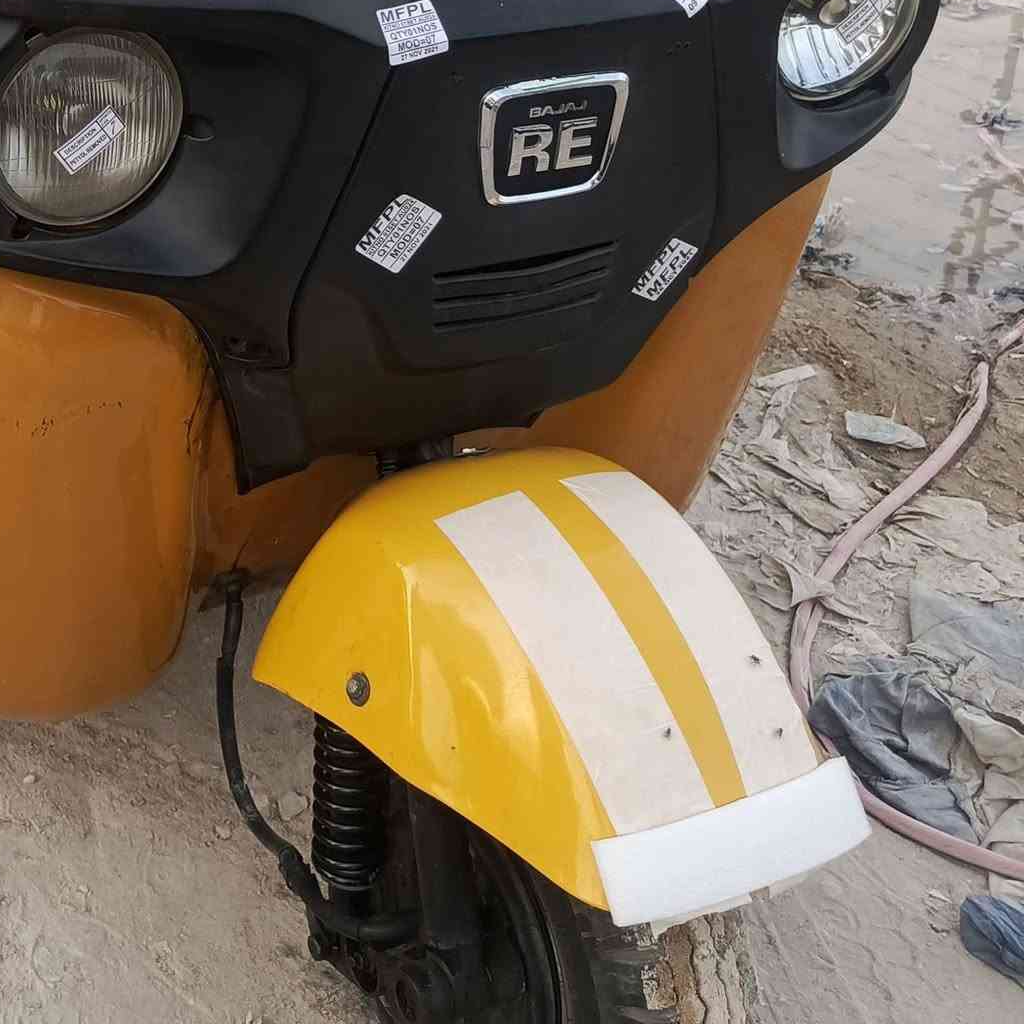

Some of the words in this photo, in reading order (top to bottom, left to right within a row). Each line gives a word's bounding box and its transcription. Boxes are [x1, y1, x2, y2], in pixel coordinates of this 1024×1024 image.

[380, 3, 433, 23] MFPL
[687, 0, 698, 11] 09
[529, 99, 588, 119] BAJAJ
[507, 116, 599, 177] RE
[358, 199, 409, 251] MFPL
[390, 216, 425, 259] MOD=07
